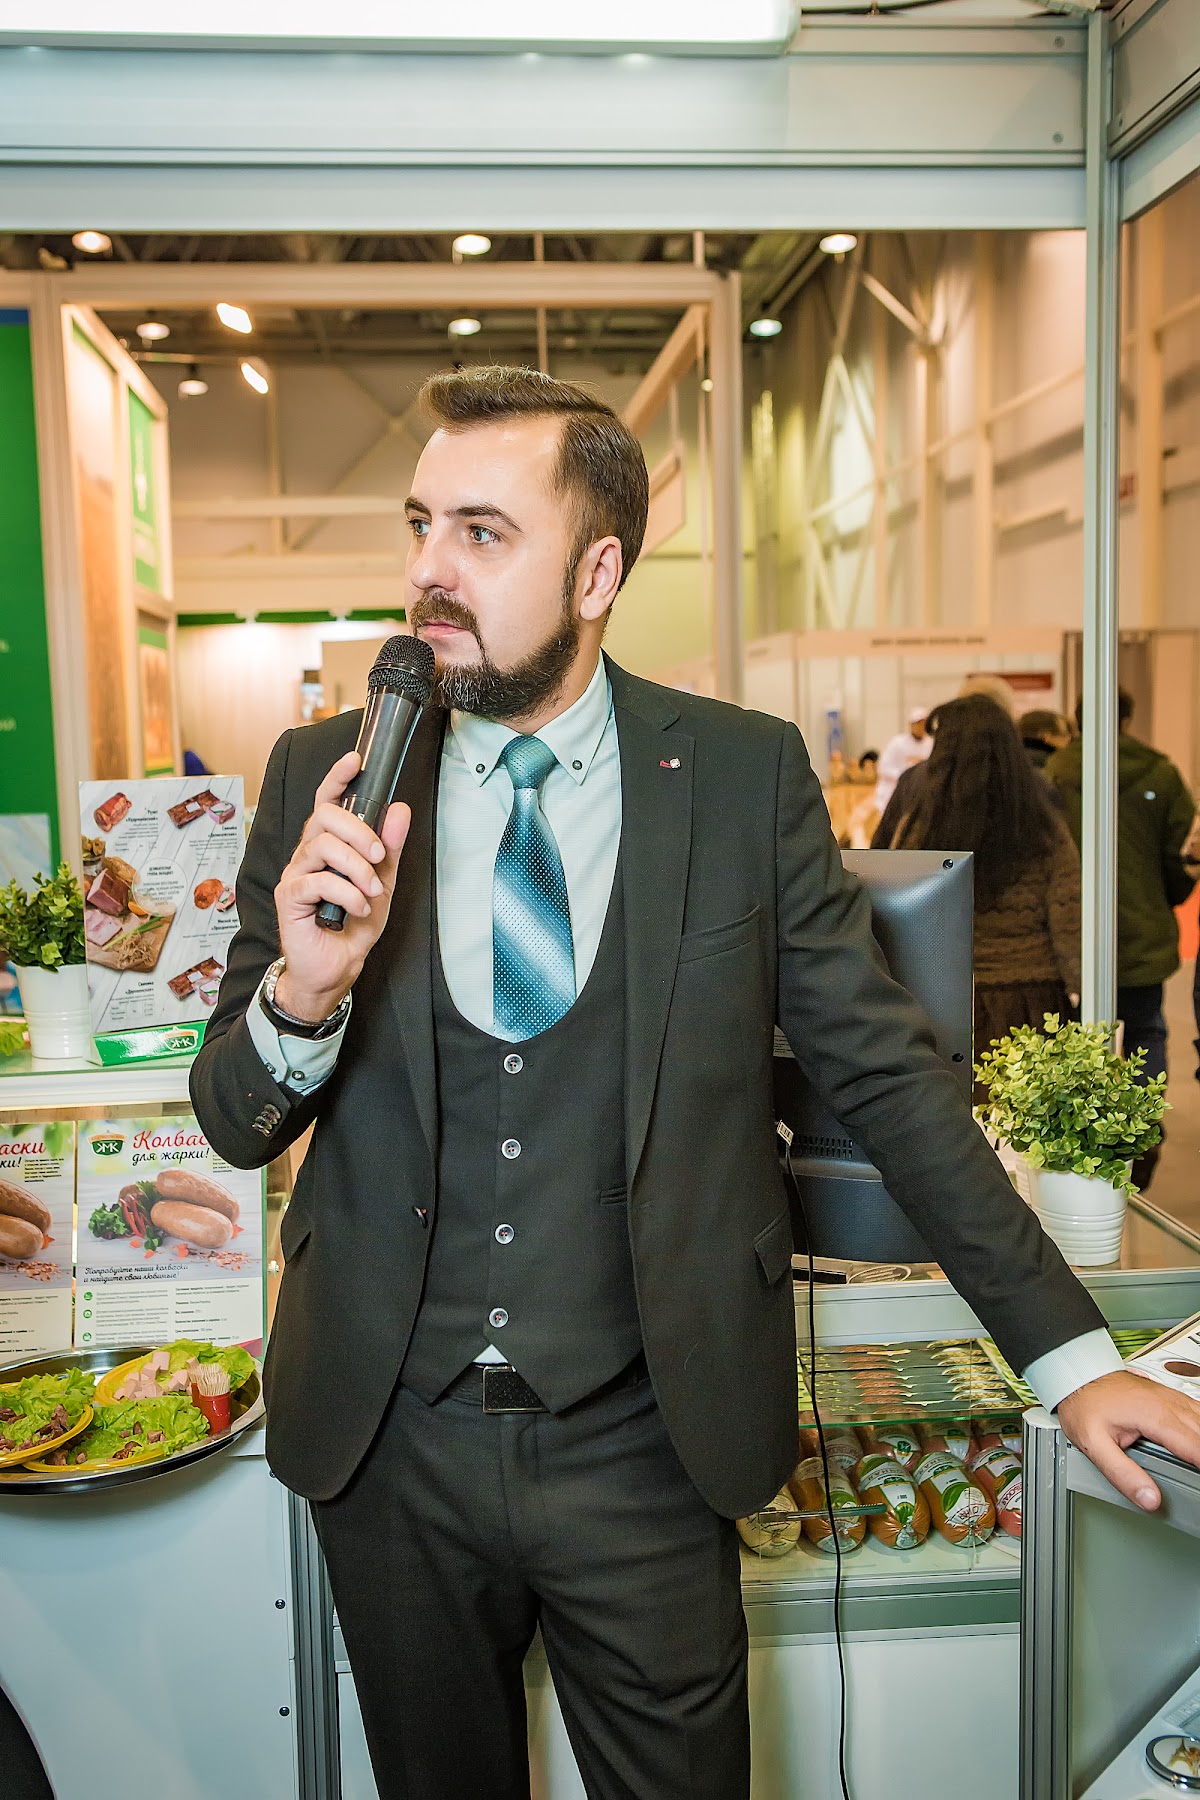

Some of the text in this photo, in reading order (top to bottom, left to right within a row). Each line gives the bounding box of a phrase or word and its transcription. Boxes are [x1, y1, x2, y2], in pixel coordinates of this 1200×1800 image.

[132, 1152, 157, 1166] для
[160, 1147, 210, 1164] жарки!
[85, 1267, 133, 1276] Попробуйте
